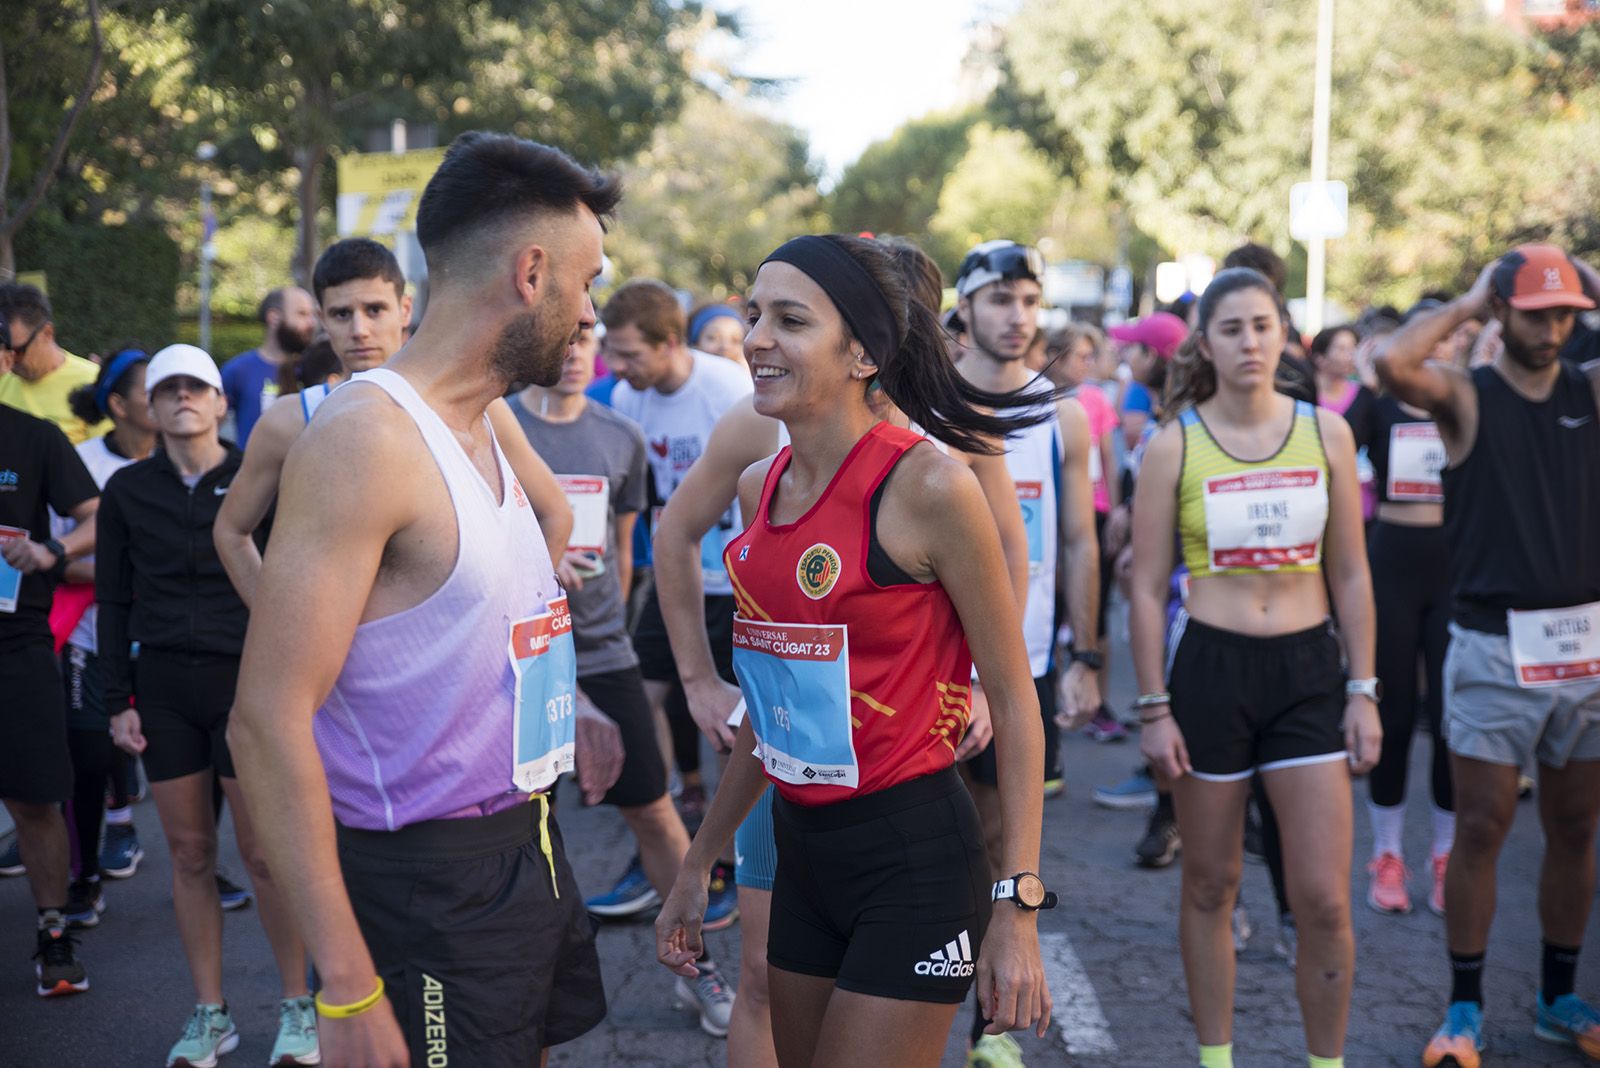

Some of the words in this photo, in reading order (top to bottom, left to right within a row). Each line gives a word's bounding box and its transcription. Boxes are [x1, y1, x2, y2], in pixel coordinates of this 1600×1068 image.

[1247, 500, 1288, 520] IRENE
[746, 627, 788, 641] UNIVERSAE
[750, 636, 772, 650] SANT
[772, 642, 814, 656] CUGAT
[814, 643, 831, 656] 23
[773, 705, 791, 732] 125
[914, 959, 975, 977] adidas
[422, 973, 448, 1068] ADIZERO
